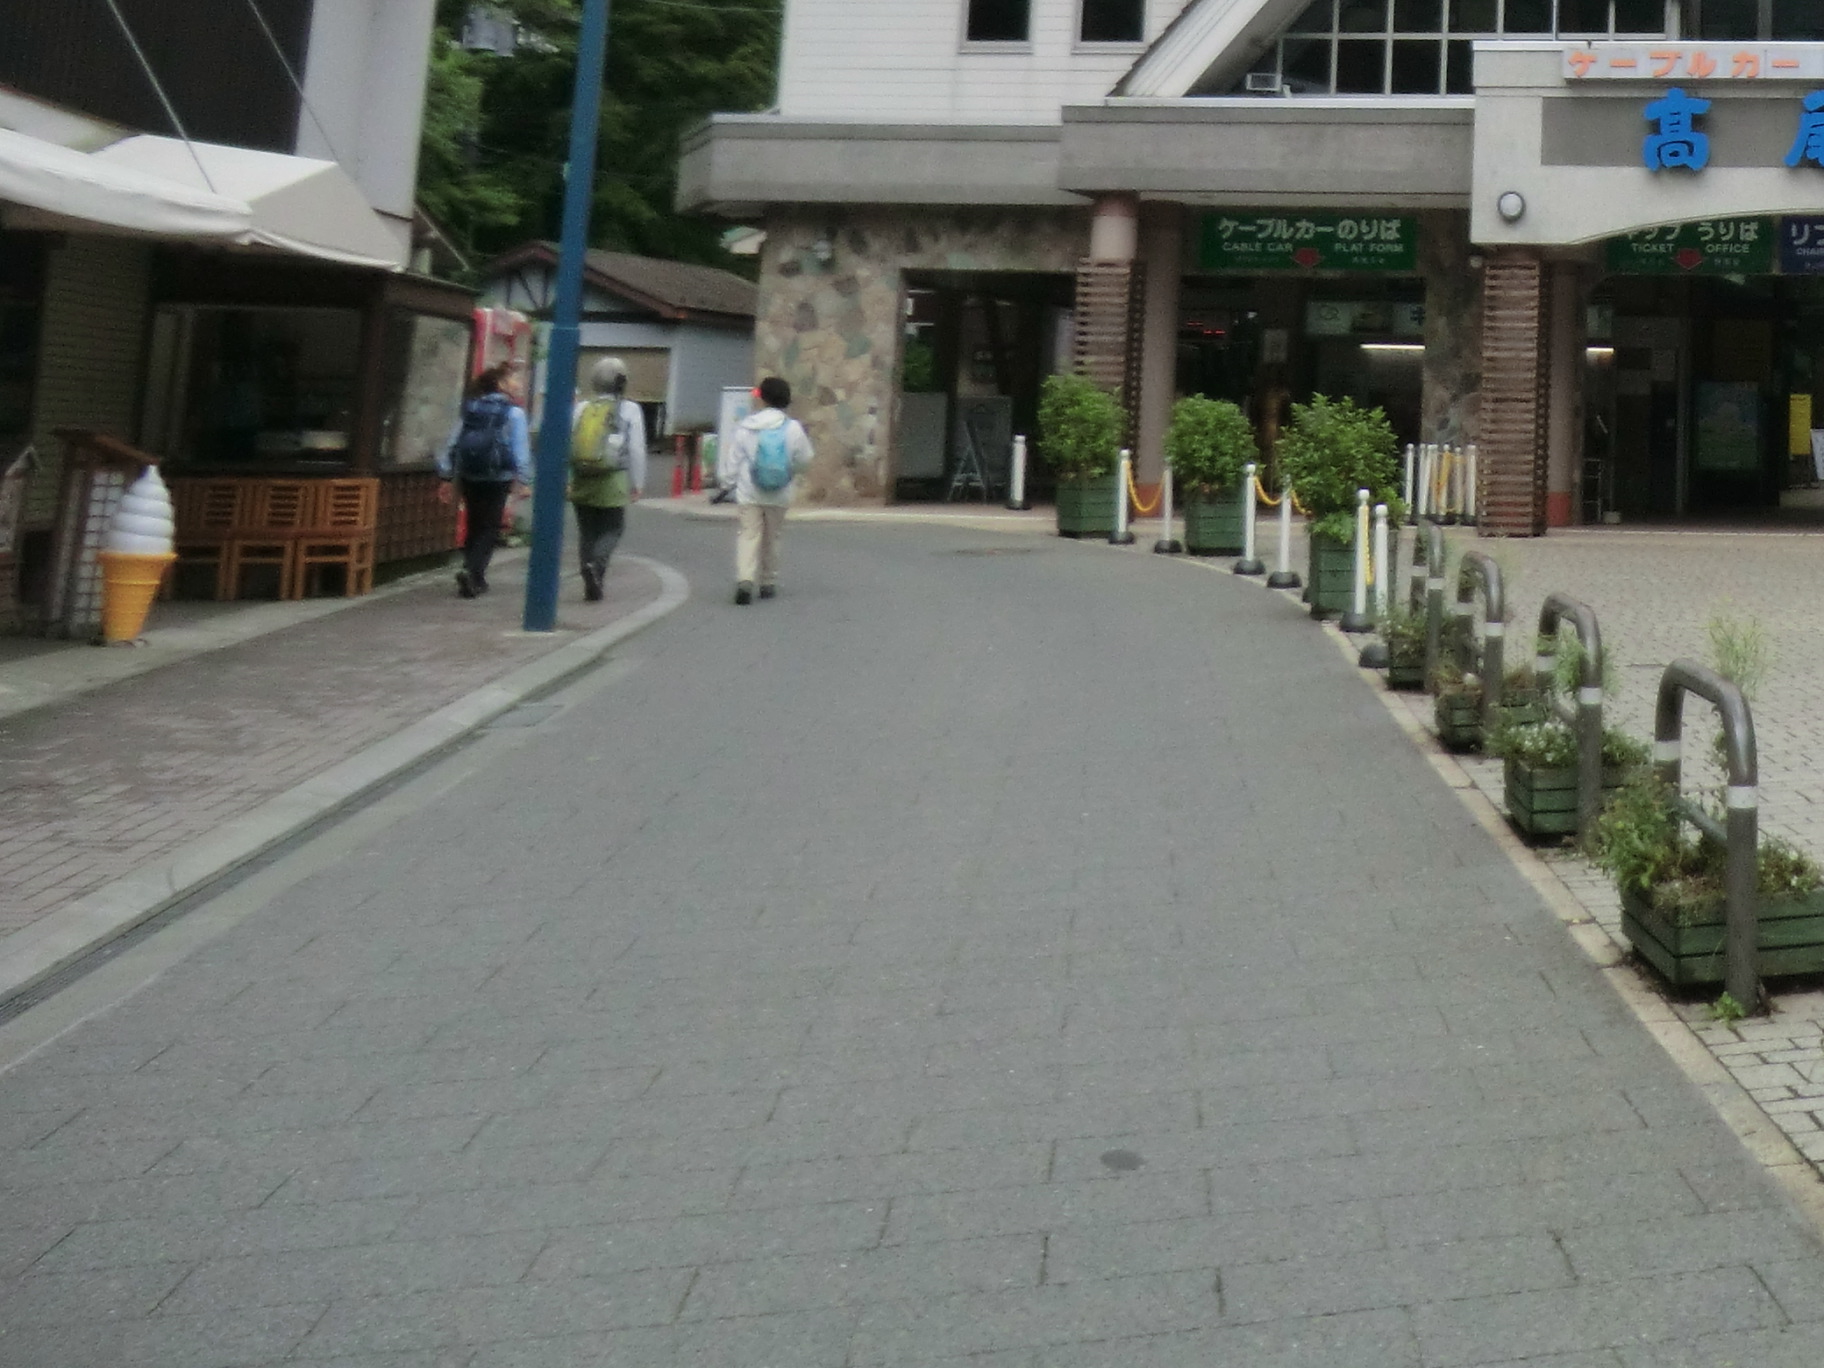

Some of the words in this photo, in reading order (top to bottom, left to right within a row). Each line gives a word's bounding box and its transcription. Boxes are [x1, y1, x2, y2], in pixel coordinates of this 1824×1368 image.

[1568, 51, 1799, 78] ケーブルカー
[1697, 221, 1759, 242] うりば
[1222, 241, 1263, 253] CABLE
[1267, 241, 1293, 253] CAR
[1334, 242, 1364, 253] PLAT
[1368, 242, 1404, 253] FORM
[1630, 243, 1675, 254] TICKET
[1705, 243, 1750, 254] OFFICE
